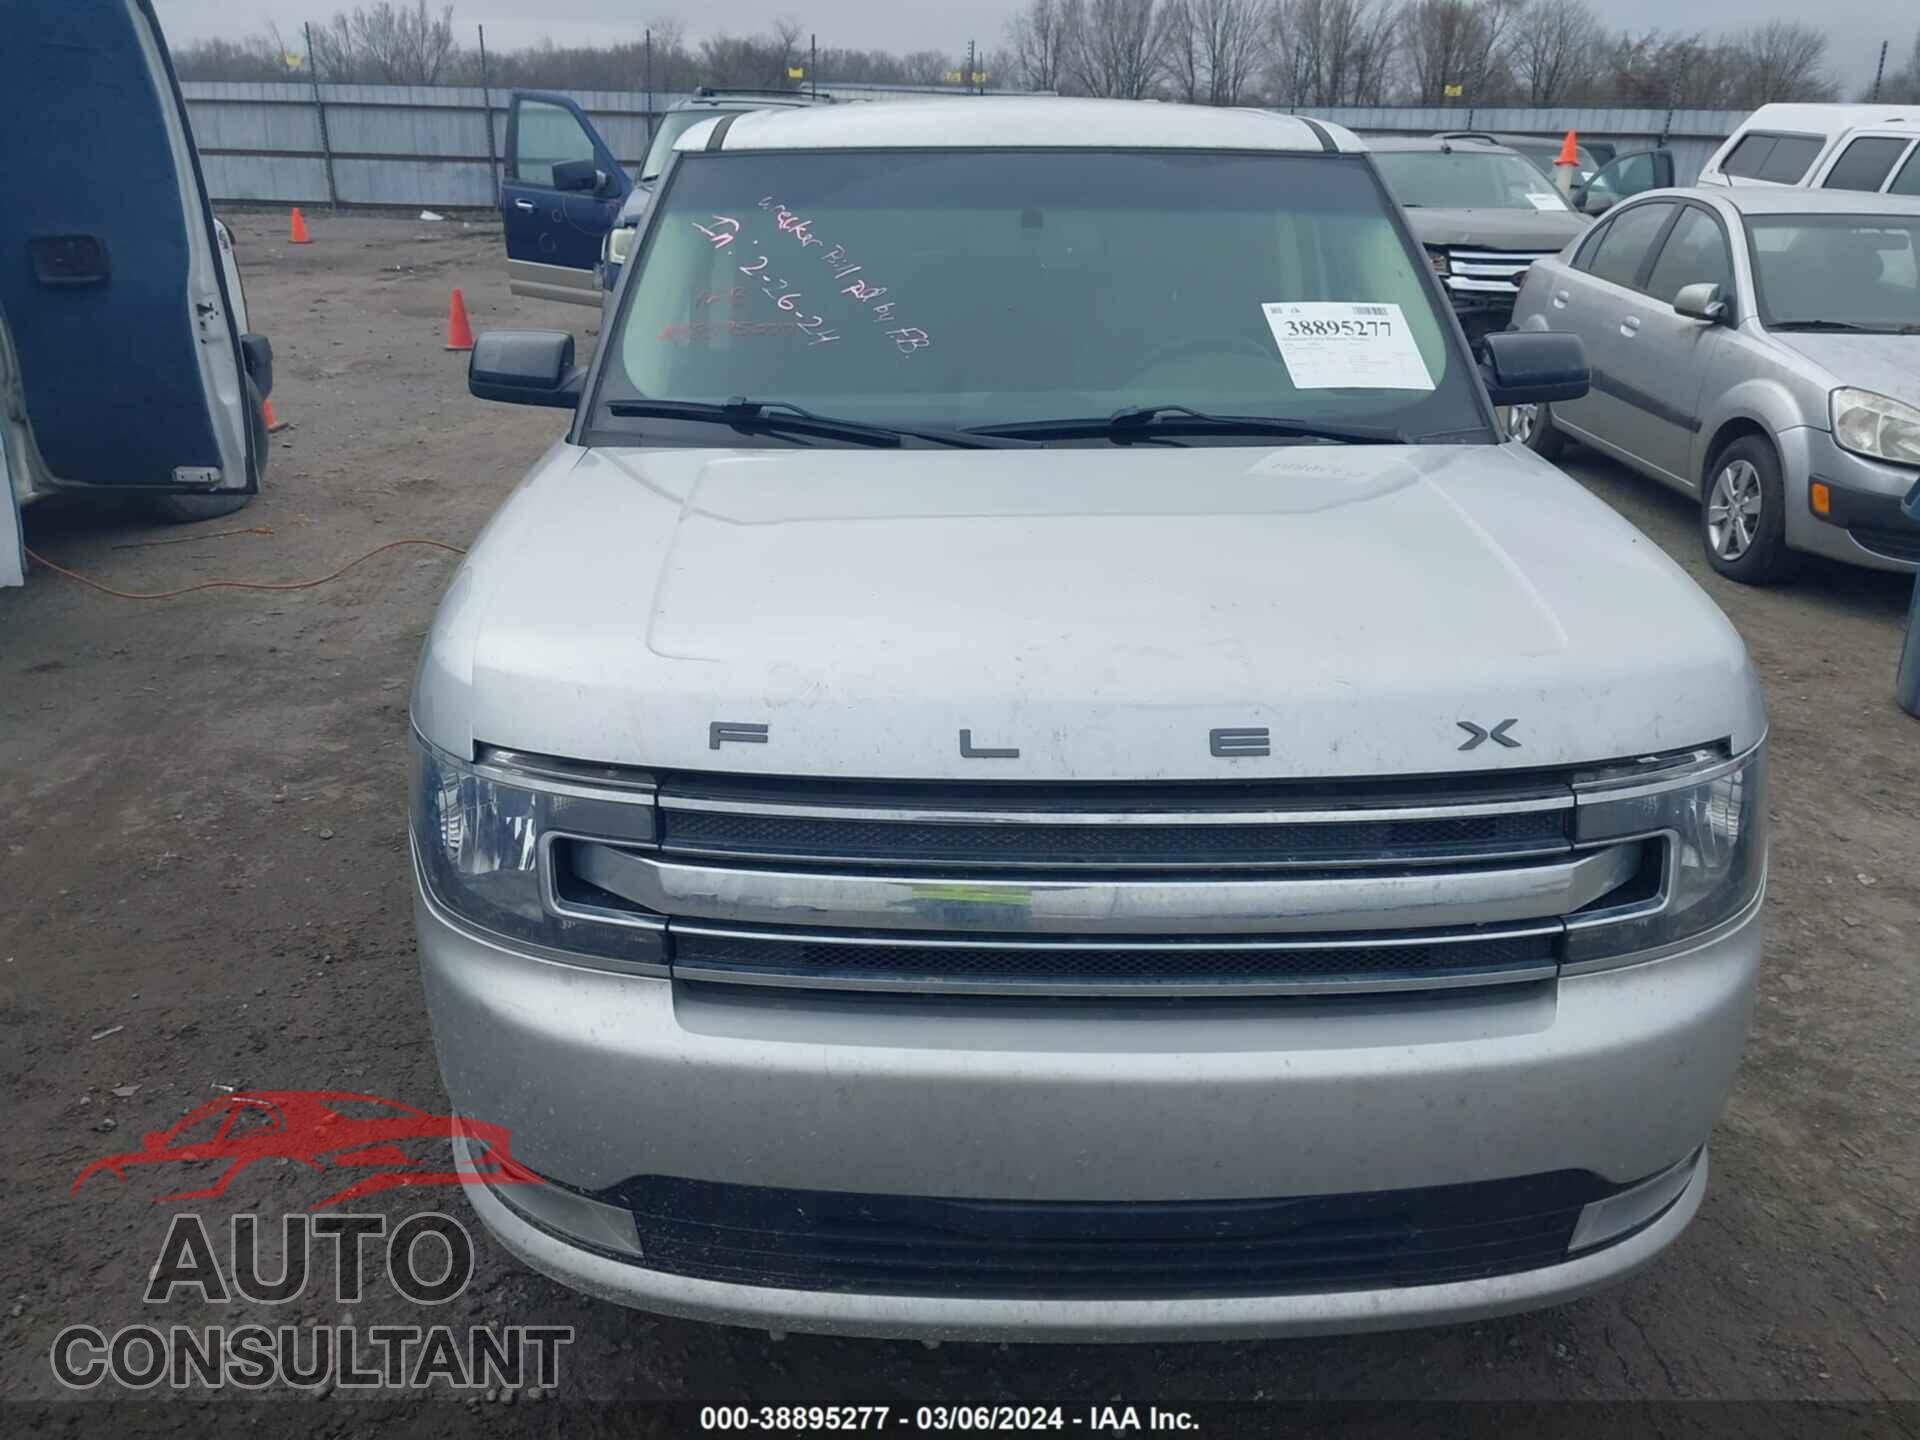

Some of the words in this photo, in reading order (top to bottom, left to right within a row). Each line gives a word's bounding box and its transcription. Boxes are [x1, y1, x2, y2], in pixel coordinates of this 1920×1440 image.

[740, 256, 840, 347] 2-26-24
[1286, 320, 1391, 337] 38895277
[709, 718, 1522, 759] FLEX
